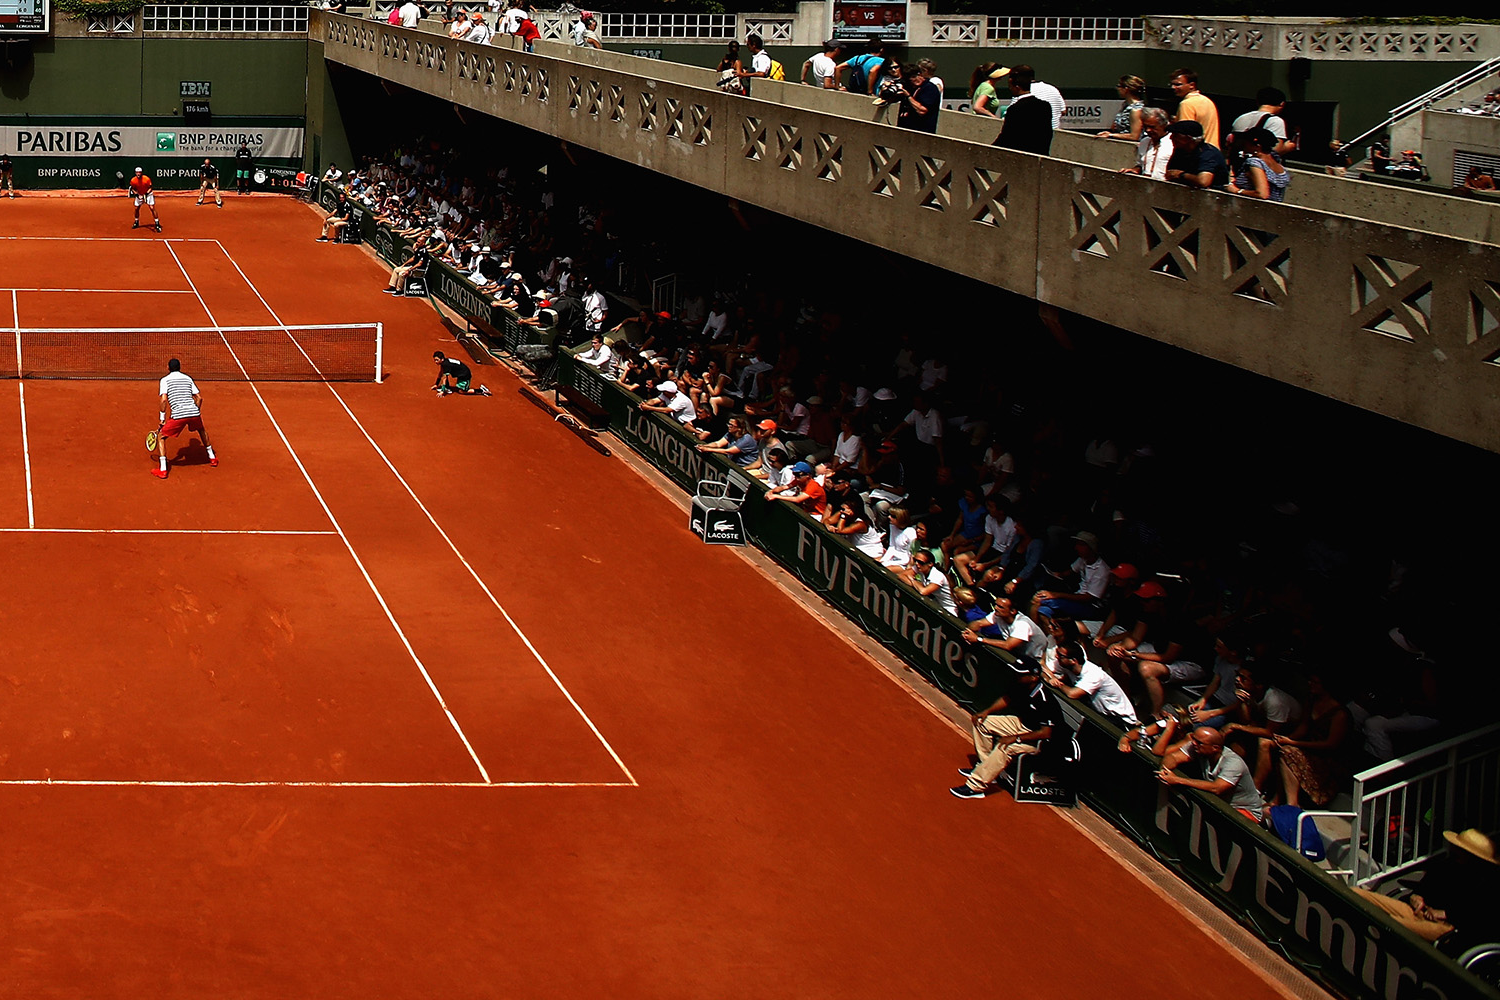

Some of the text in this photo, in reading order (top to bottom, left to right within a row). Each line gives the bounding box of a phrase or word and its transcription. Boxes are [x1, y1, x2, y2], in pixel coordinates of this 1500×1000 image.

[863, 12, 875, 20] VS
[181, 82, 210, 95] IBM
[17, 131, 122, 152] PARIBAS
[179, 133, 263, 145] BNP PARIBAS
[38, 168, 101, 178] BNP PARIBAS
[156, 169, 200, 178] BNP PARI
[440, 273, 492, 325] LONGINES
[625, 404, 730, 497] LONGINES
[707, 531, 739, 540] LACOSTE
[797, 522, 979, 688] Fly Emirates
[1020, 785, 1066, 796] LACOSTE
